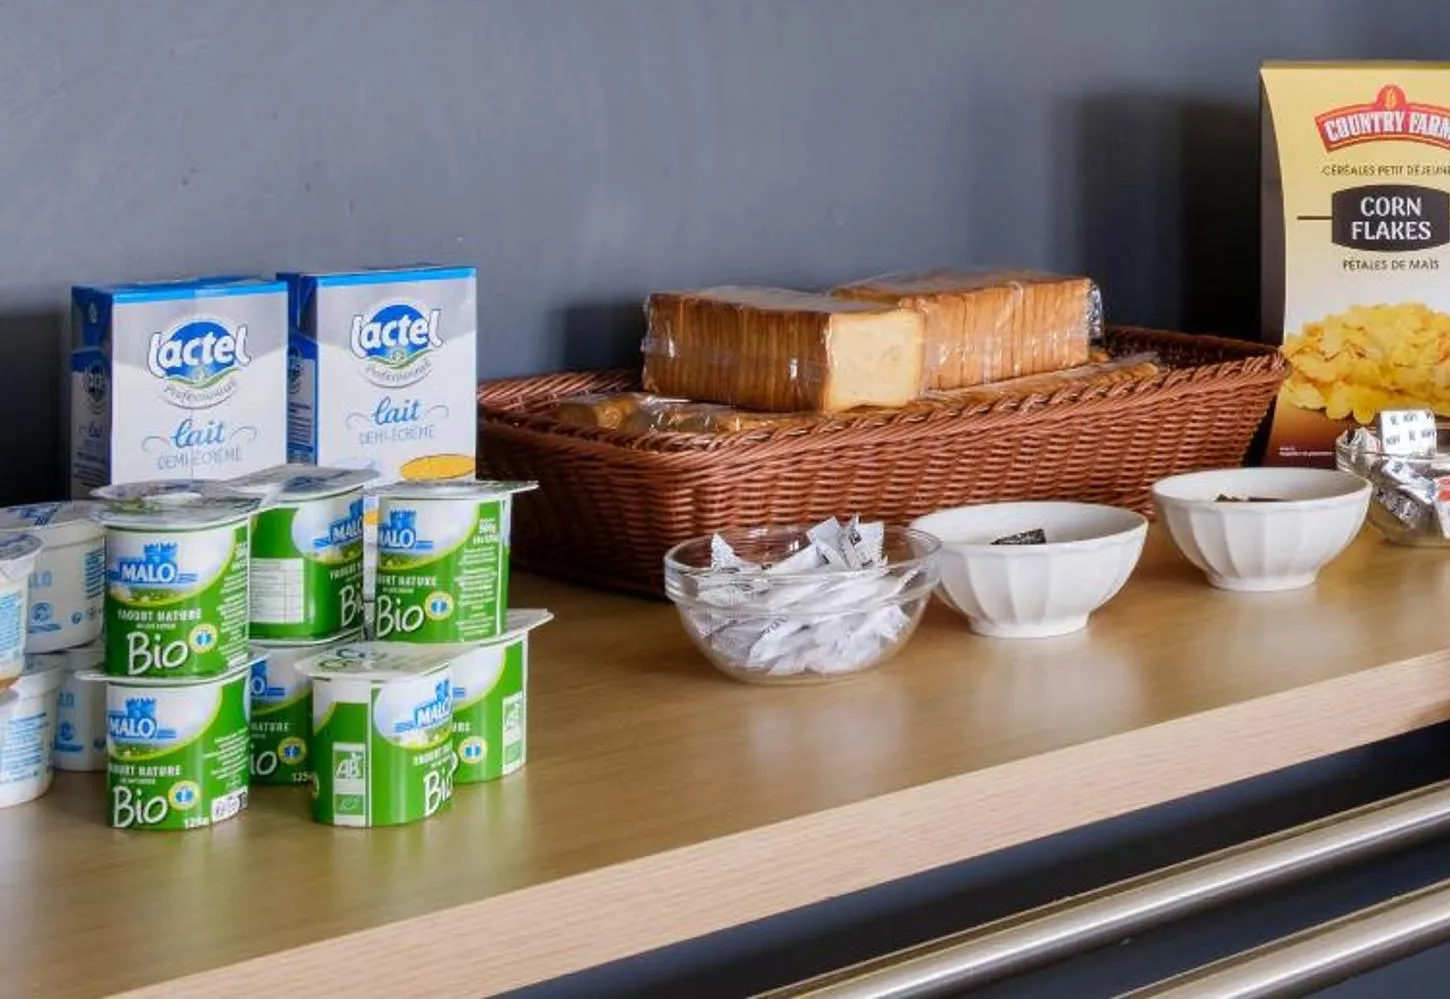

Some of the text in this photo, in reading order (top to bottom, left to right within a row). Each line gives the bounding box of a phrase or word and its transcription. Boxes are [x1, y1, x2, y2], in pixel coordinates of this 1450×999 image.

[1324, 110, 1405, 142] COUNTRY
[1378, 164, 1402, 176] PETIT
[1360, 196, 1422, 217] CORN
[1351, 220, 1432, 241] FLAKES
[1391, 259, 1406, 270] DE
[373, 397, 421, 425] lait
[171, 419, 226, 448] lait
[119, 563, 176, 583] MALO
[376, 594, 425, 638] Bio
[126, 631, 188, 675] Bio
[112, 786, 168, 828] Bio
